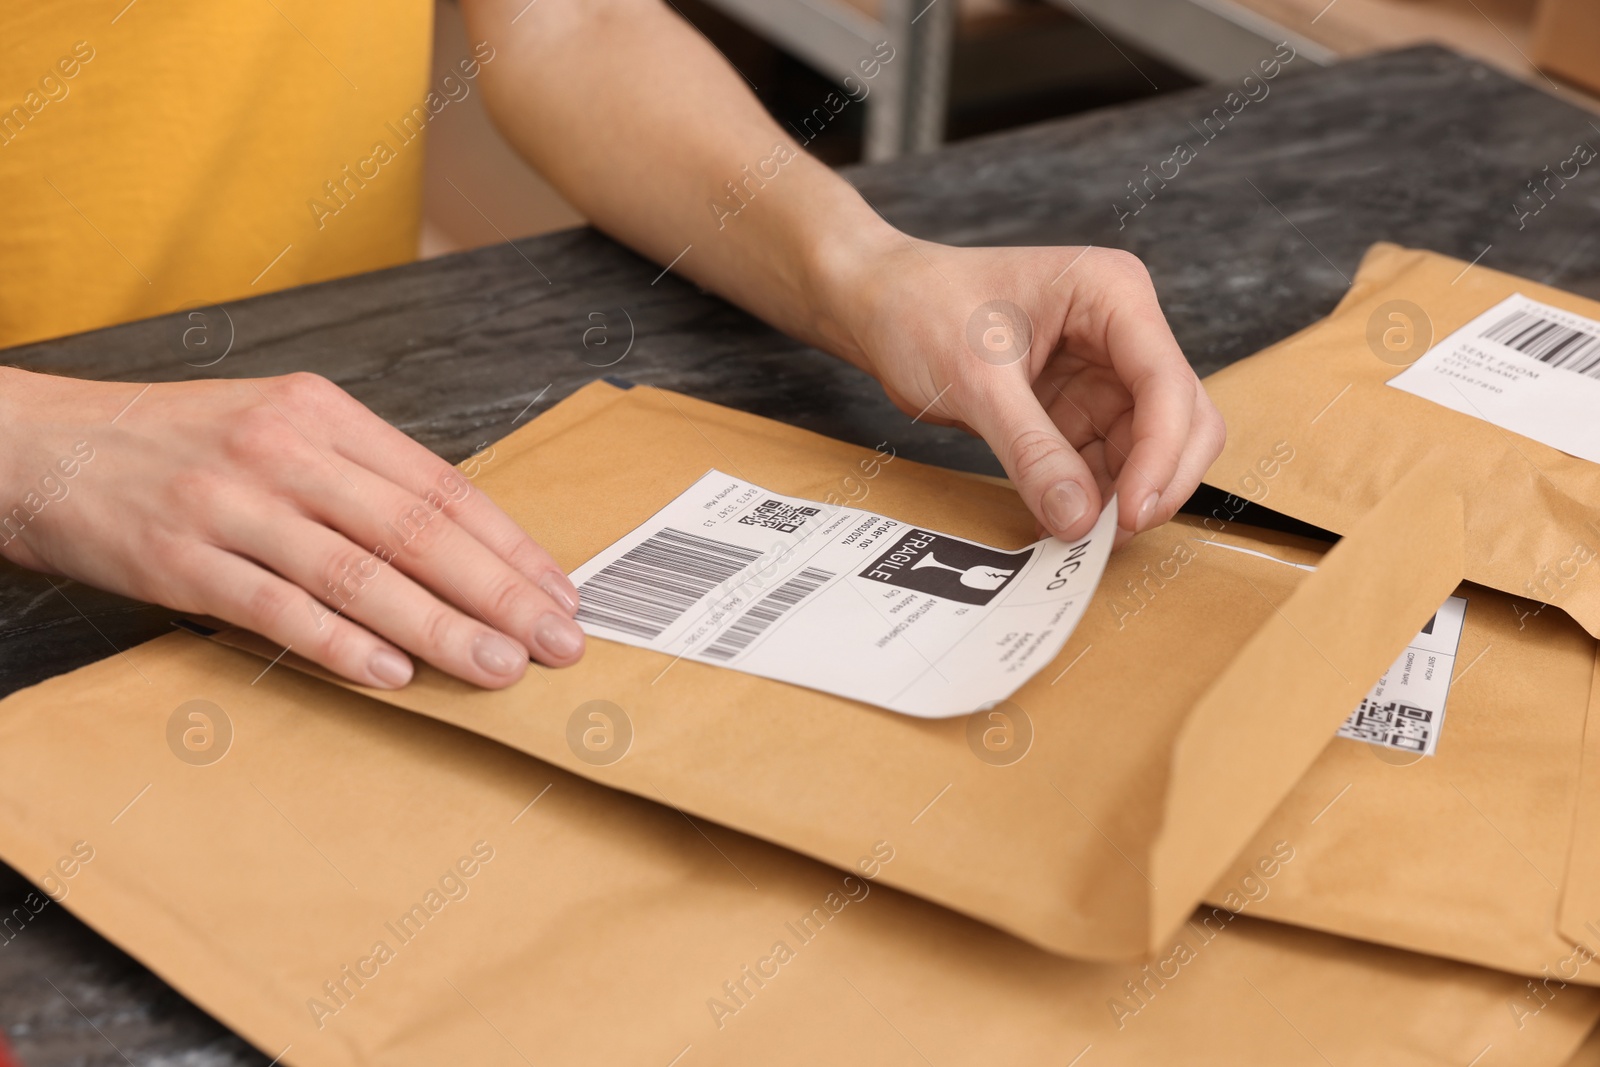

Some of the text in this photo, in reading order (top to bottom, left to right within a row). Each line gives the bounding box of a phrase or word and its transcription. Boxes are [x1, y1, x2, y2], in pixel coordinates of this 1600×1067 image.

[1442, 356, 1471, 370] CITY
[1451, 350, 1521, 382] YOUR NAME
[1459, 343, 1541, 380] SENT FROM
[1432, 365, 1504, 395] 1234567890
[703, 483, 739, 510] Priority Mail
[703, 488, 758, 528] 8473 3347 13
[870, 520, 898, 540] Order
[867, 532, 936, 581] FRAGILE
[882, 588, 901, 599] City
[889, 593, 918, 614] Address
[874, 598, 937, 648] ANOTHER COMPANY
[1400, 652, 1416, 686] COMPANY NAME
[1424, 656, 1437, 681] SENT FROM
